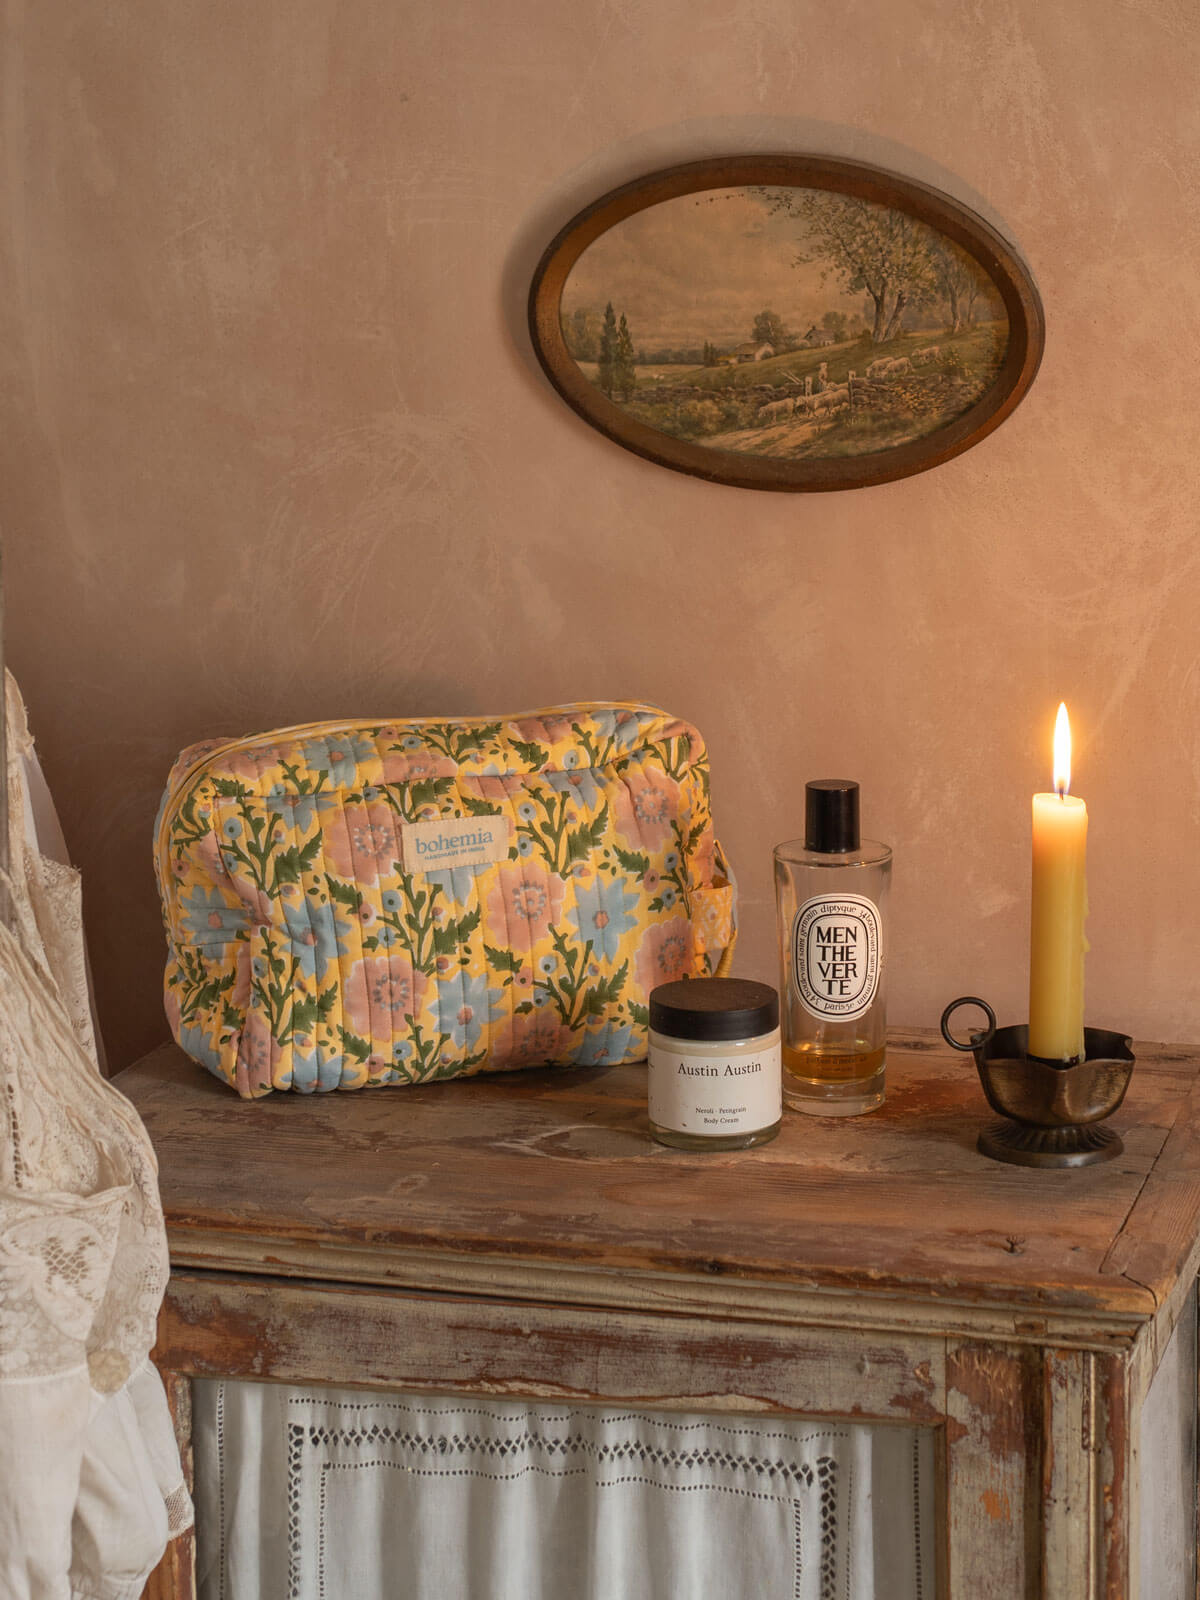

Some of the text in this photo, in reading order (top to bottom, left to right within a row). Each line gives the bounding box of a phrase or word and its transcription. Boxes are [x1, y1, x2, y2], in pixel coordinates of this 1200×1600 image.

[415, 828, 494, 854] bohemia
[820, 904, 857, 913] diptyque
[816, 926, 857, 943] MEN
[816, 944, 857, 961] THE
[816, 962, 858, 978] VER
[822, 979, 851, 995] TE
[677, 1062, 762, 1077] Austin Austin
